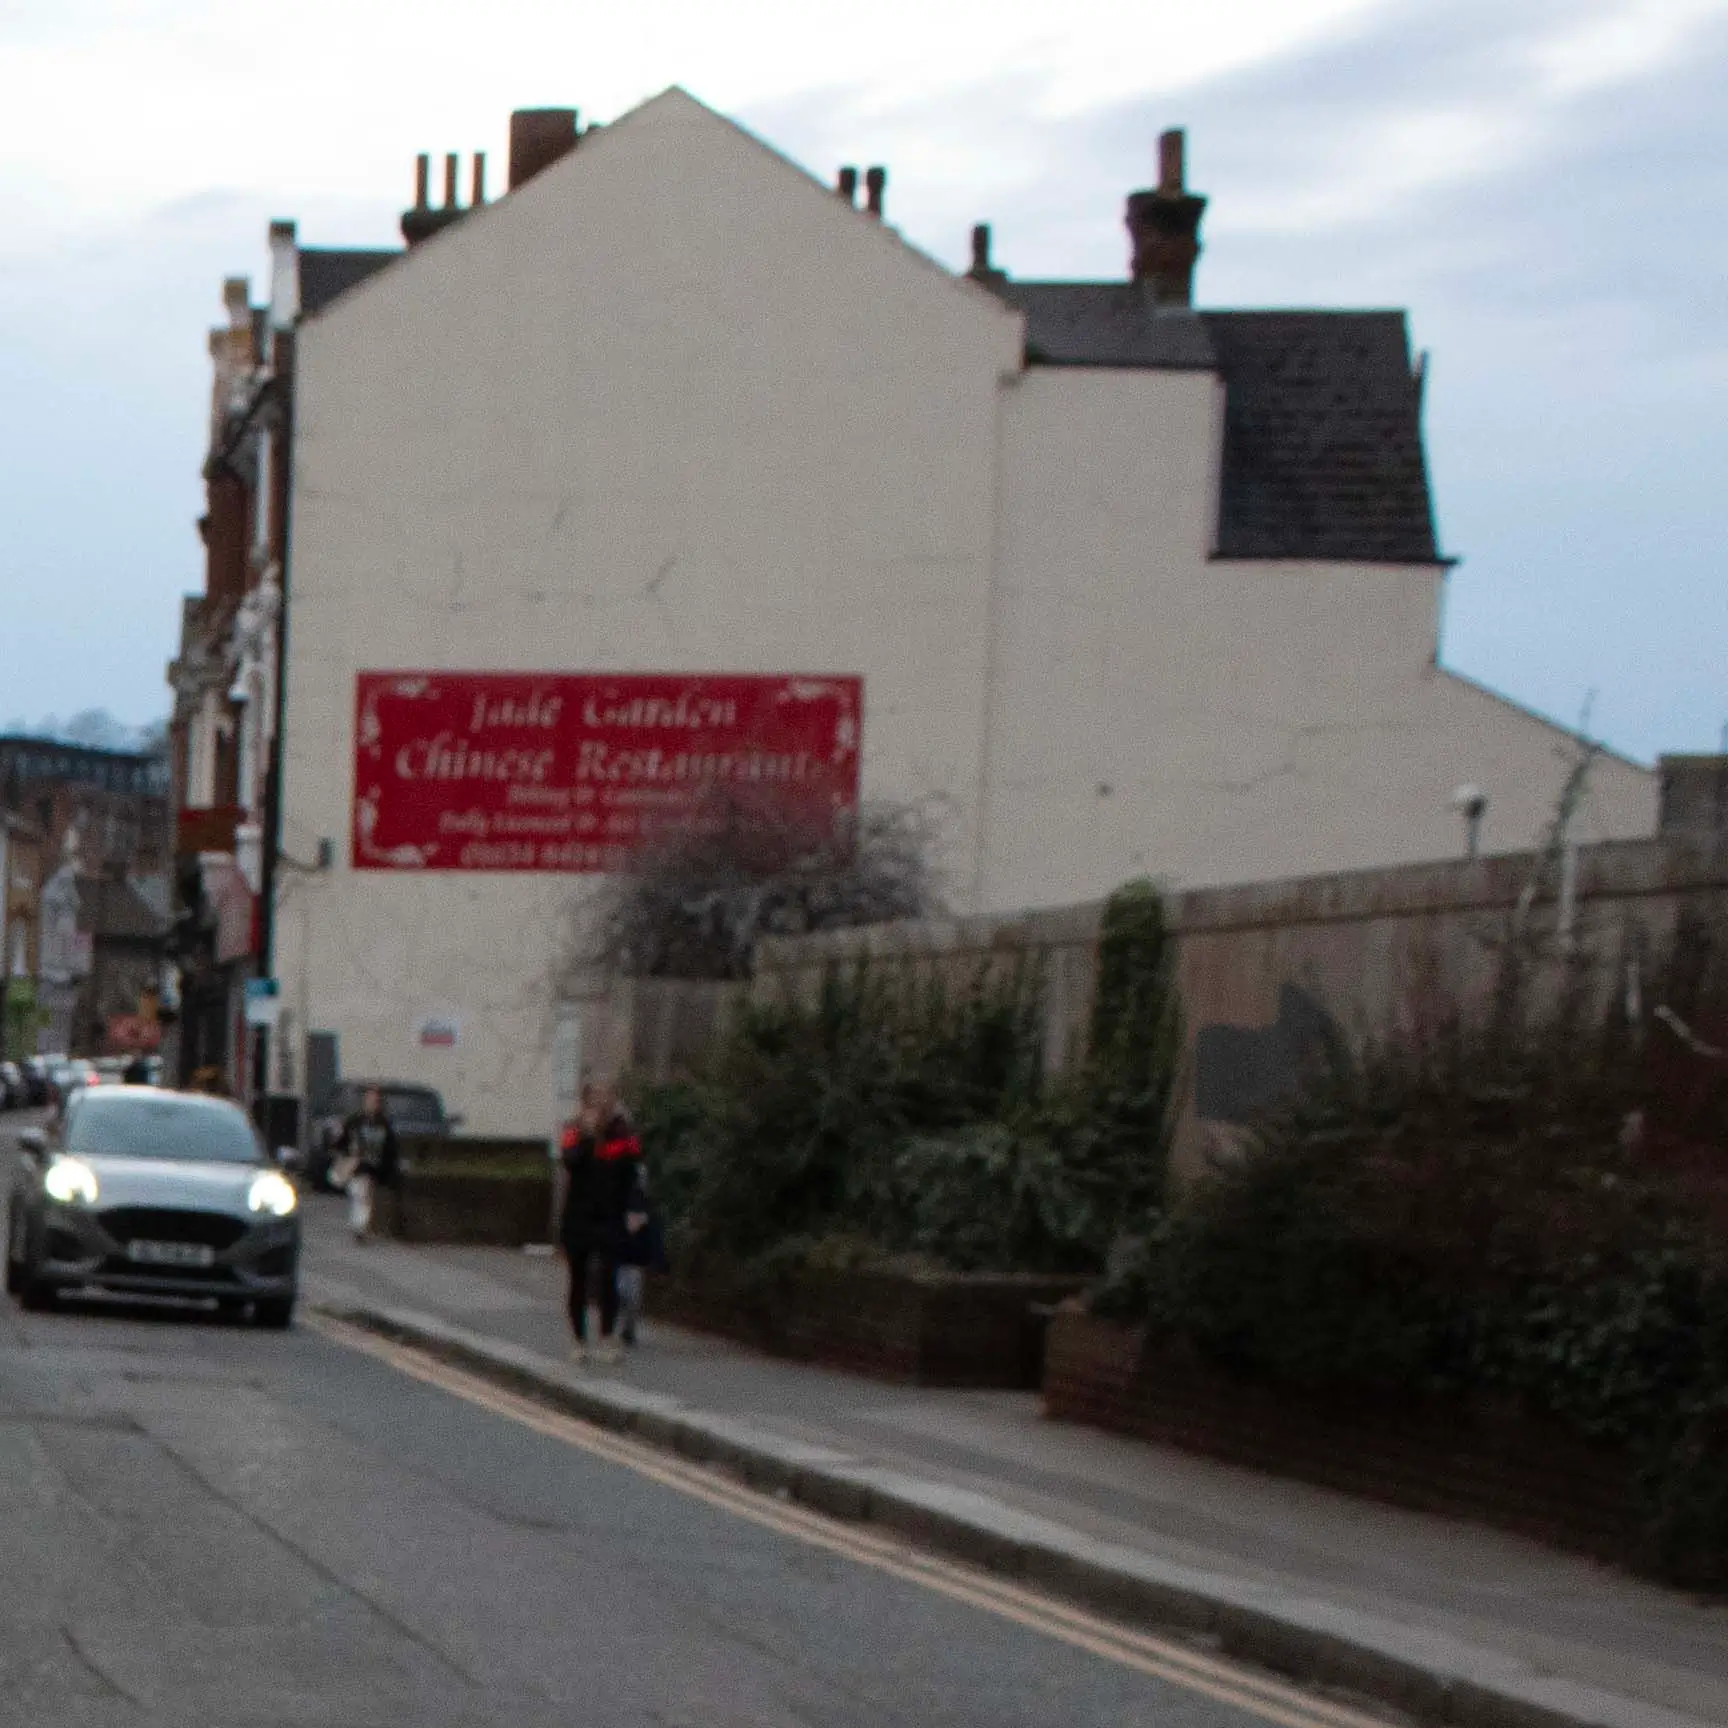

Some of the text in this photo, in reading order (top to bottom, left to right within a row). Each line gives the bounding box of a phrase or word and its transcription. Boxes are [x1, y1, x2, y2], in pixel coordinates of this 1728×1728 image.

[469, 689, 738, 734] Jade Garden
[393, 730, 556, 781] Chinese
